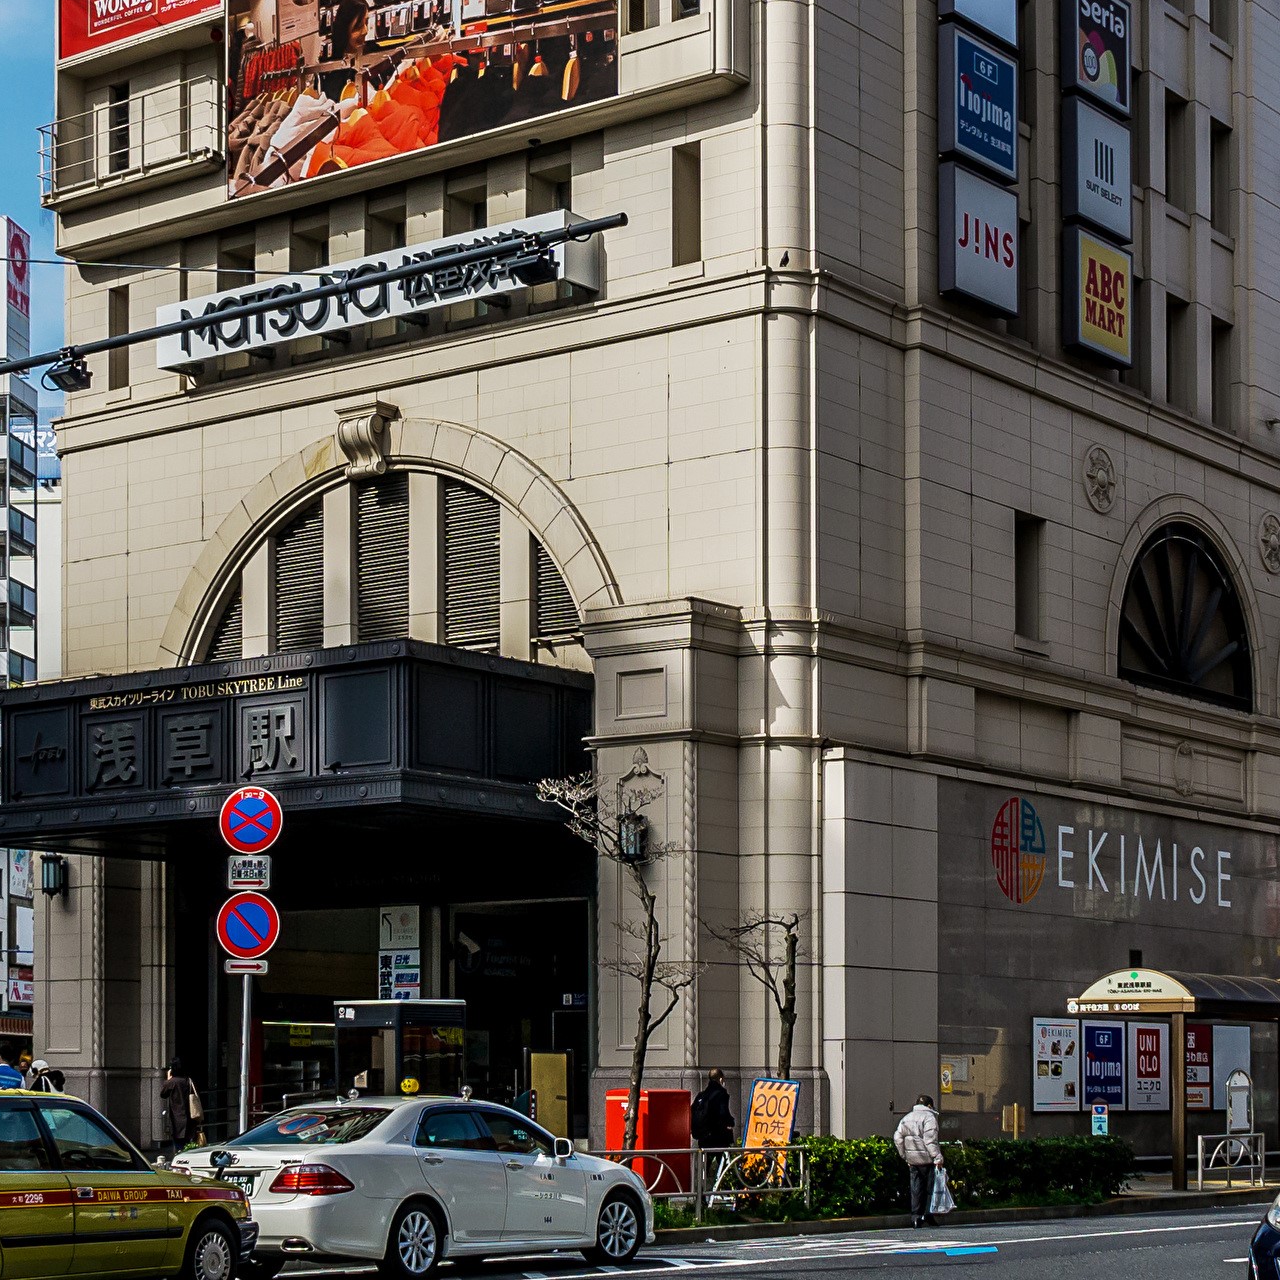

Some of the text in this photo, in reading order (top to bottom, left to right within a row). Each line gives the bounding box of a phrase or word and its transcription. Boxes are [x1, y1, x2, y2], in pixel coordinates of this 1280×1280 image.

[94, 6, 143, 27] WONDERFUL COFFEE
[979, 59, 993, 77] 6F
[1085, 179, 1123, 207] SUIT SELECT
[1085, 257, 1125, 310] ABC
[1085, 297, 1125, 339] MART
[89, 674, 303, 711] 東武スカイツリーライン TOBU SKYTREE Line
[91, 706, 298, 784] 浅草駅
[1057, 824, 1233, 908] EKIMISE
[394, 954, 410, 965] 日光
[1048, 1028, 1072, 1038] EKIMISE
[1099, 1034, 1109, 1044] 6F
[1139, 1035, 1157, 1052] UNI
[1139, 1055, 1158, 1075] QLO
[1136, 1080, 1161, 1091] ユニクロ
[754, 1094, 791, 1118] 200
[754, 1119, 785, 1136] m先
[24, 1193, 44, 1203] 2296
[97, 1189, 183, 1202] DAIWA GROUP TAXI
